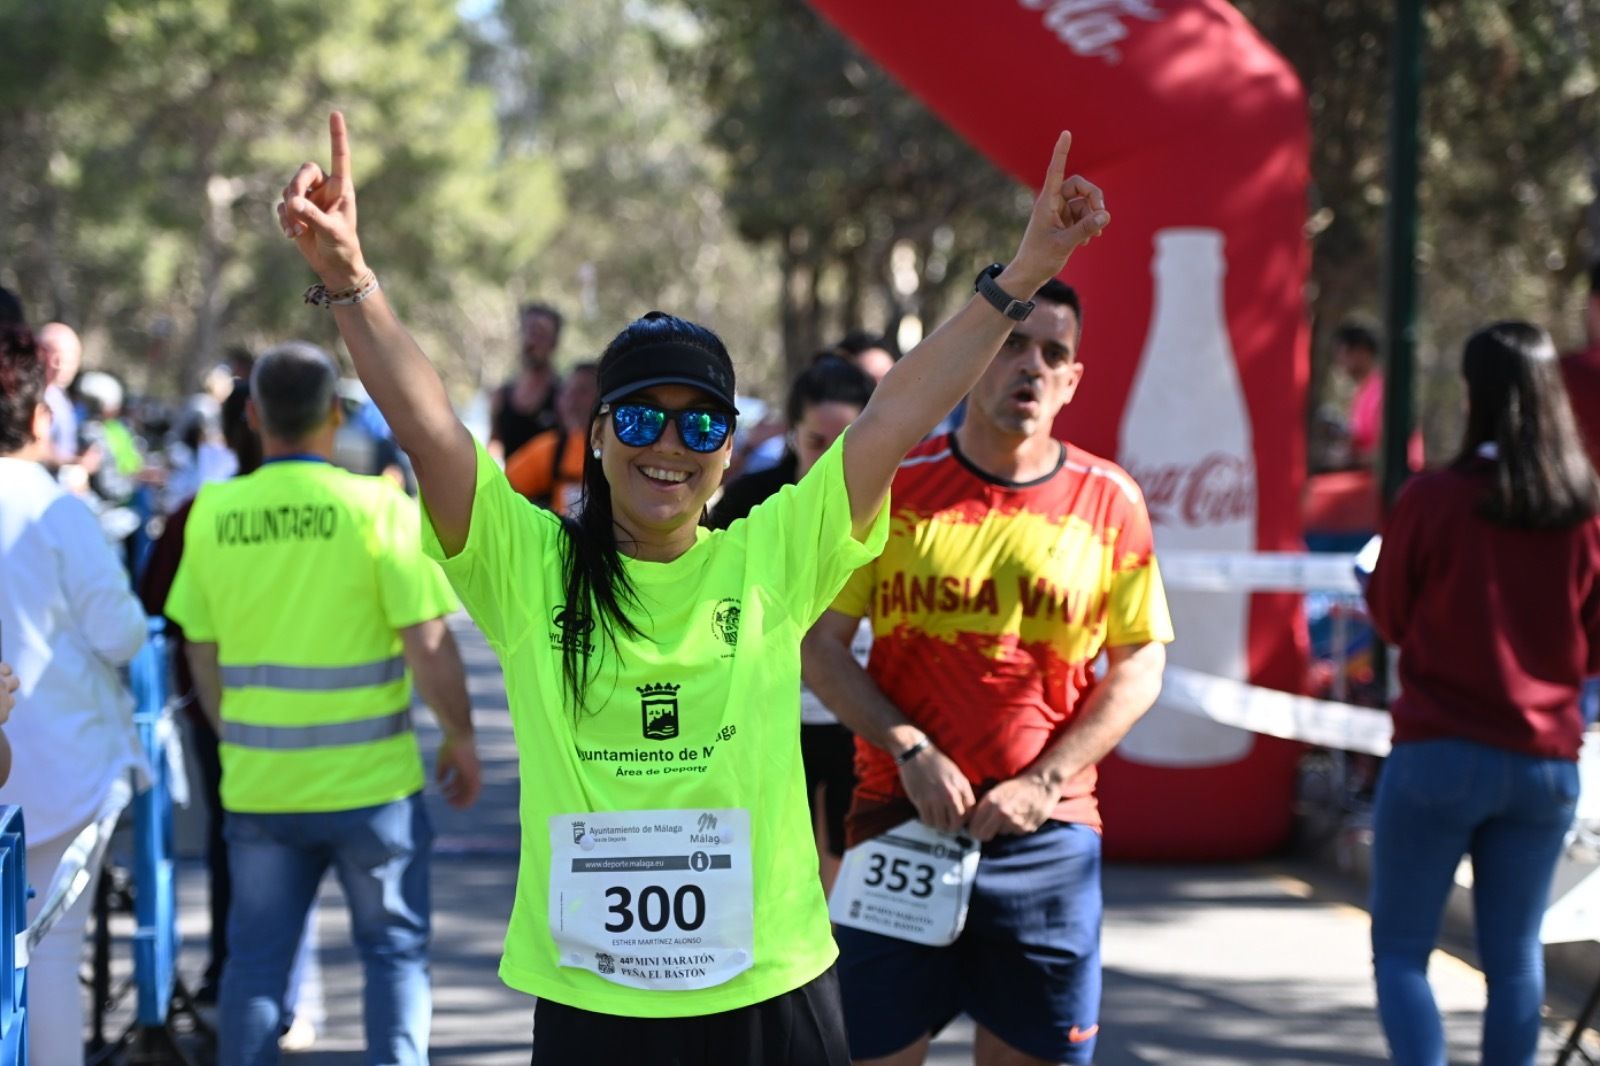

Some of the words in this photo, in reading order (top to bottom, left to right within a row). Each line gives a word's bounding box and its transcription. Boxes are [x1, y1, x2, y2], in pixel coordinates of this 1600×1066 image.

[215, 505, 338, 545] VOLUNTARIO
[577, 748, 674, 762] yuntamiento
[679, 748, 698, 761] de
[615, 766, 643, 777] Área
[646, 767, 660, 775] de
[663, 765, 708, 774] Deporte
[589, 825, 640, 836] Ayuntamiento
[642, 825, 652, 833] de
[654, 824, 683, 834] Málaga
[690, 832, 721, 845] Málag
[864, 853, 936, 899] 353
[604, 884, 706, 933] 300
[674, 937, 702, 945] ALONSO
[635, 956, 660, 966] MINI
[662, 953, 716, 966] MARATÓN
[621, 967, 646, 978] PEÑA
[649, 970, 662, 979] EL
